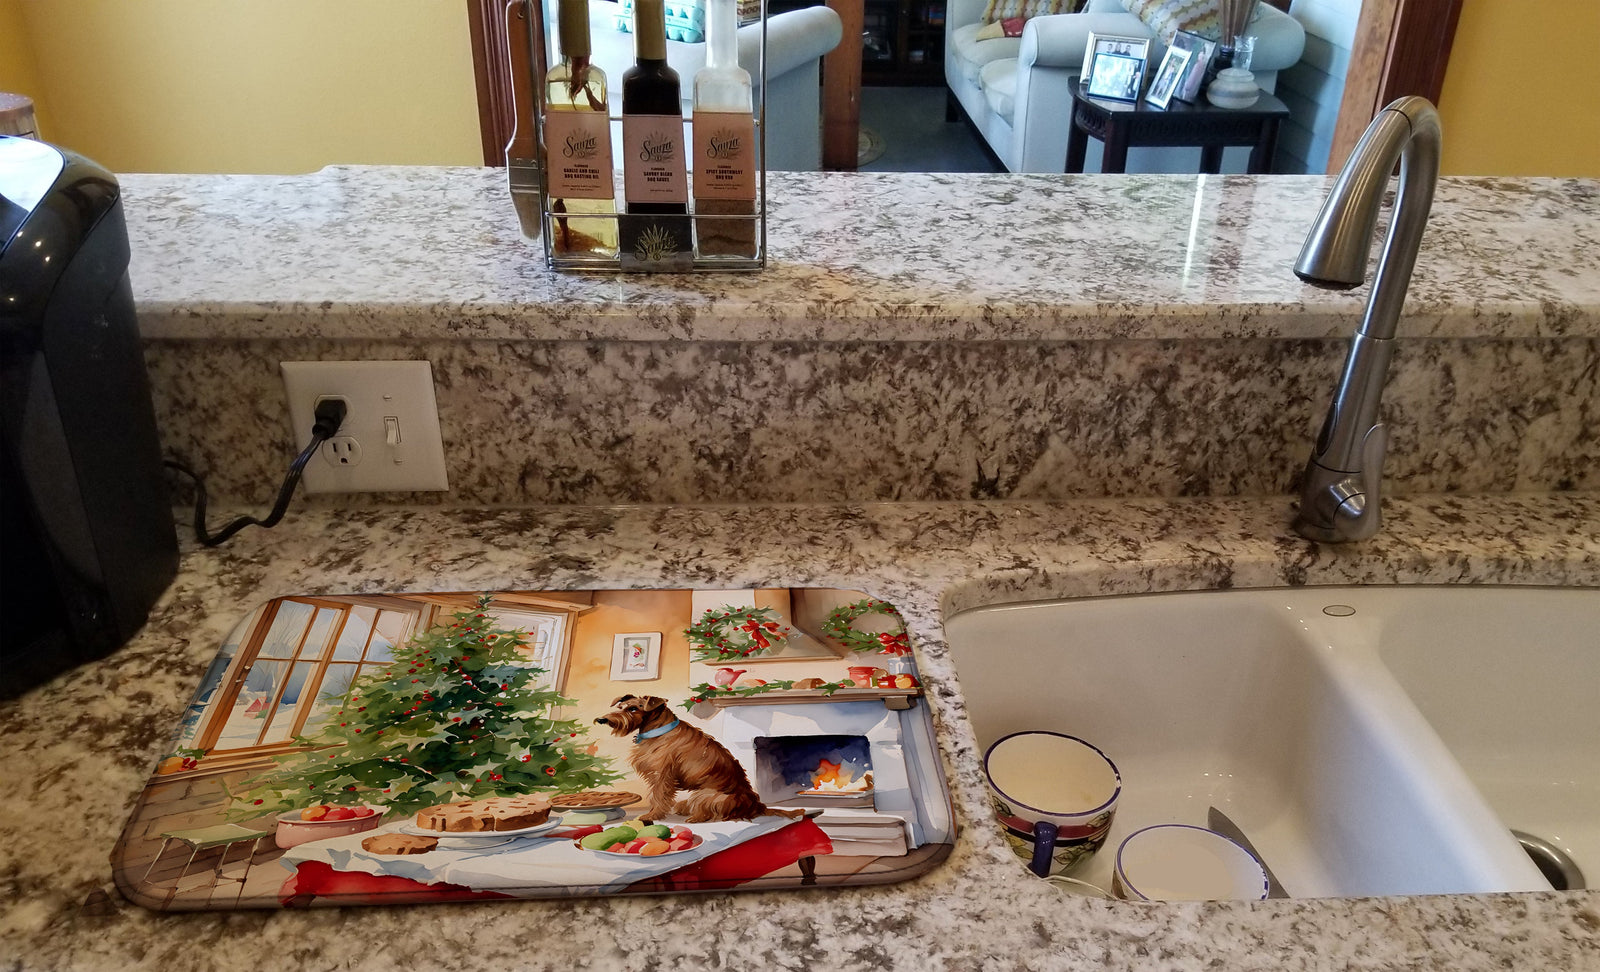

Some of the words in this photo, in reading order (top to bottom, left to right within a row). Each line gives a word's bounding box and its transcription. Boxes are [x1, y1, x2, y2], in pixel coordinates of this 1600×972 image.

[563, 135, 597, 158] Sauza
[640, 140, 674, 162] Sauza
[707, 136, 740, 159] Sauza
